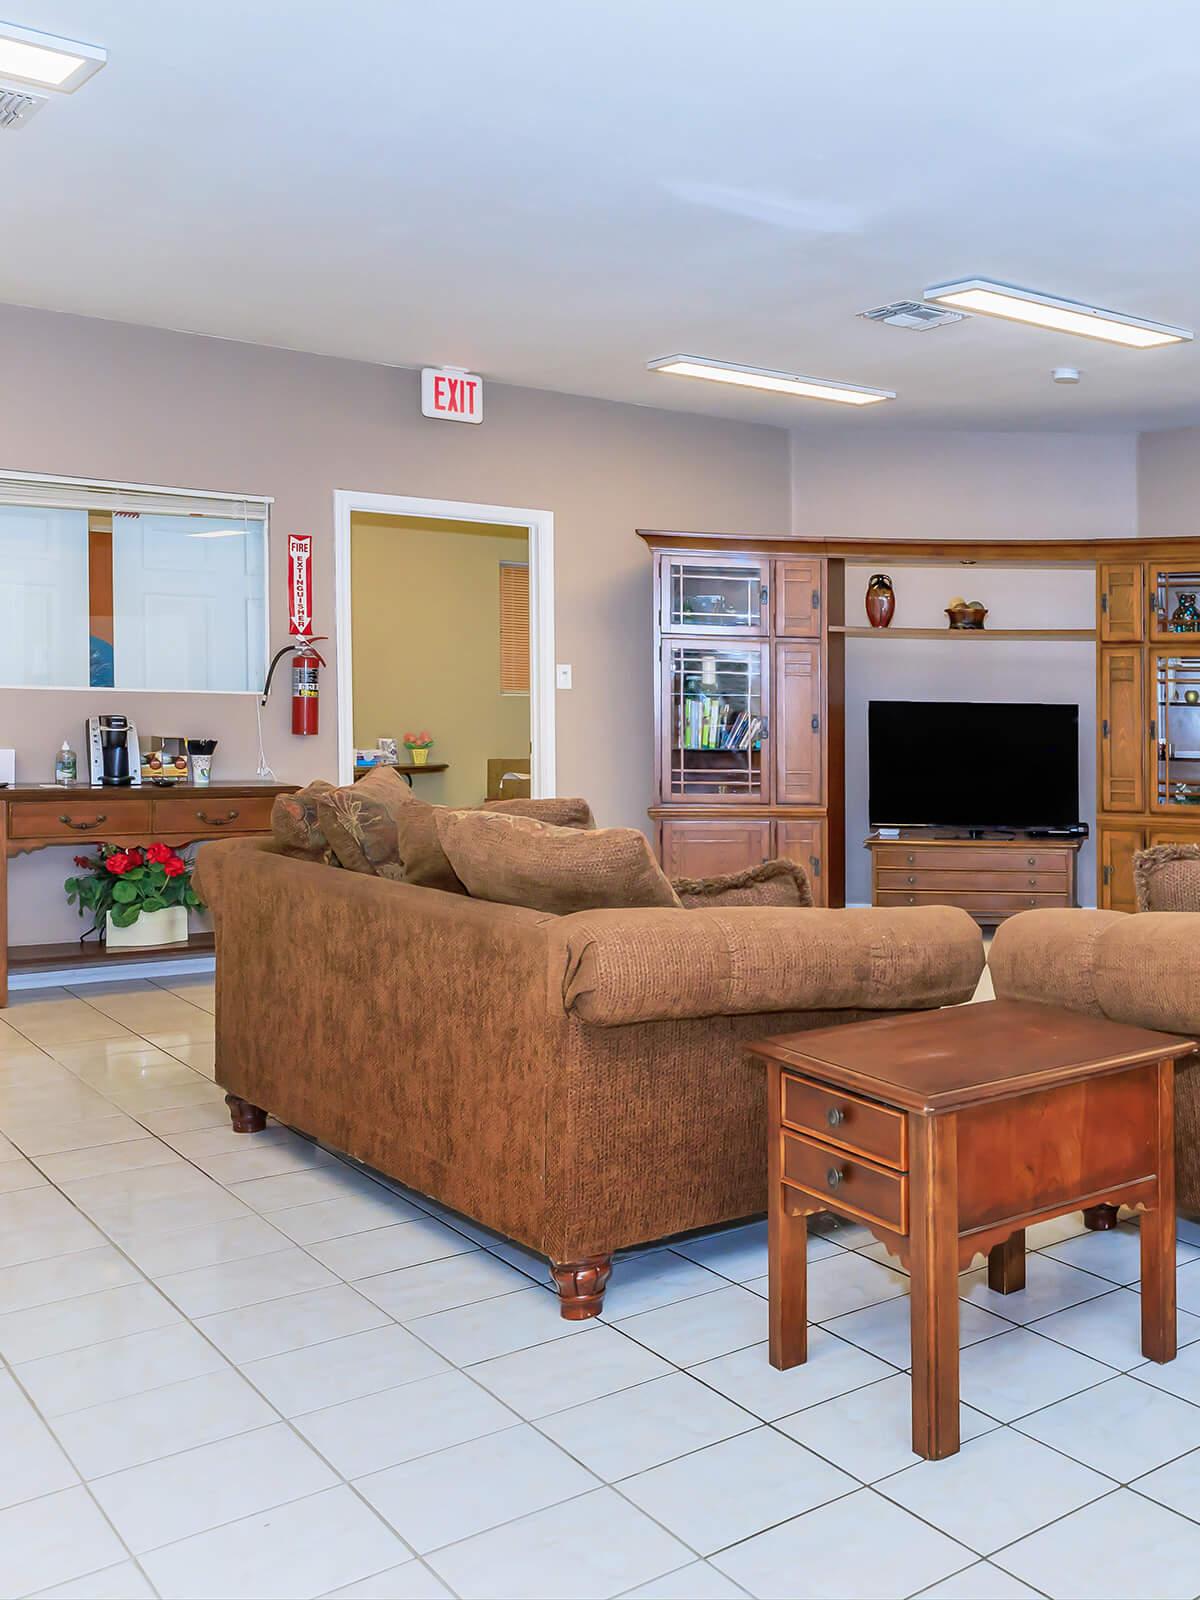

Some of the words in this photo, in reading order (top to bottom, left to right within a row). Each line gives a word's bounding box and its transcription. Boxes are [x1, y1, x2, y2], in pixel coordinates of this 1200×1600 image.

[434, 376, 477, 415] EXIT
[291, 542, 308, 552] FIRE
[296, 556, 304, 627] EXTINGUISHER
